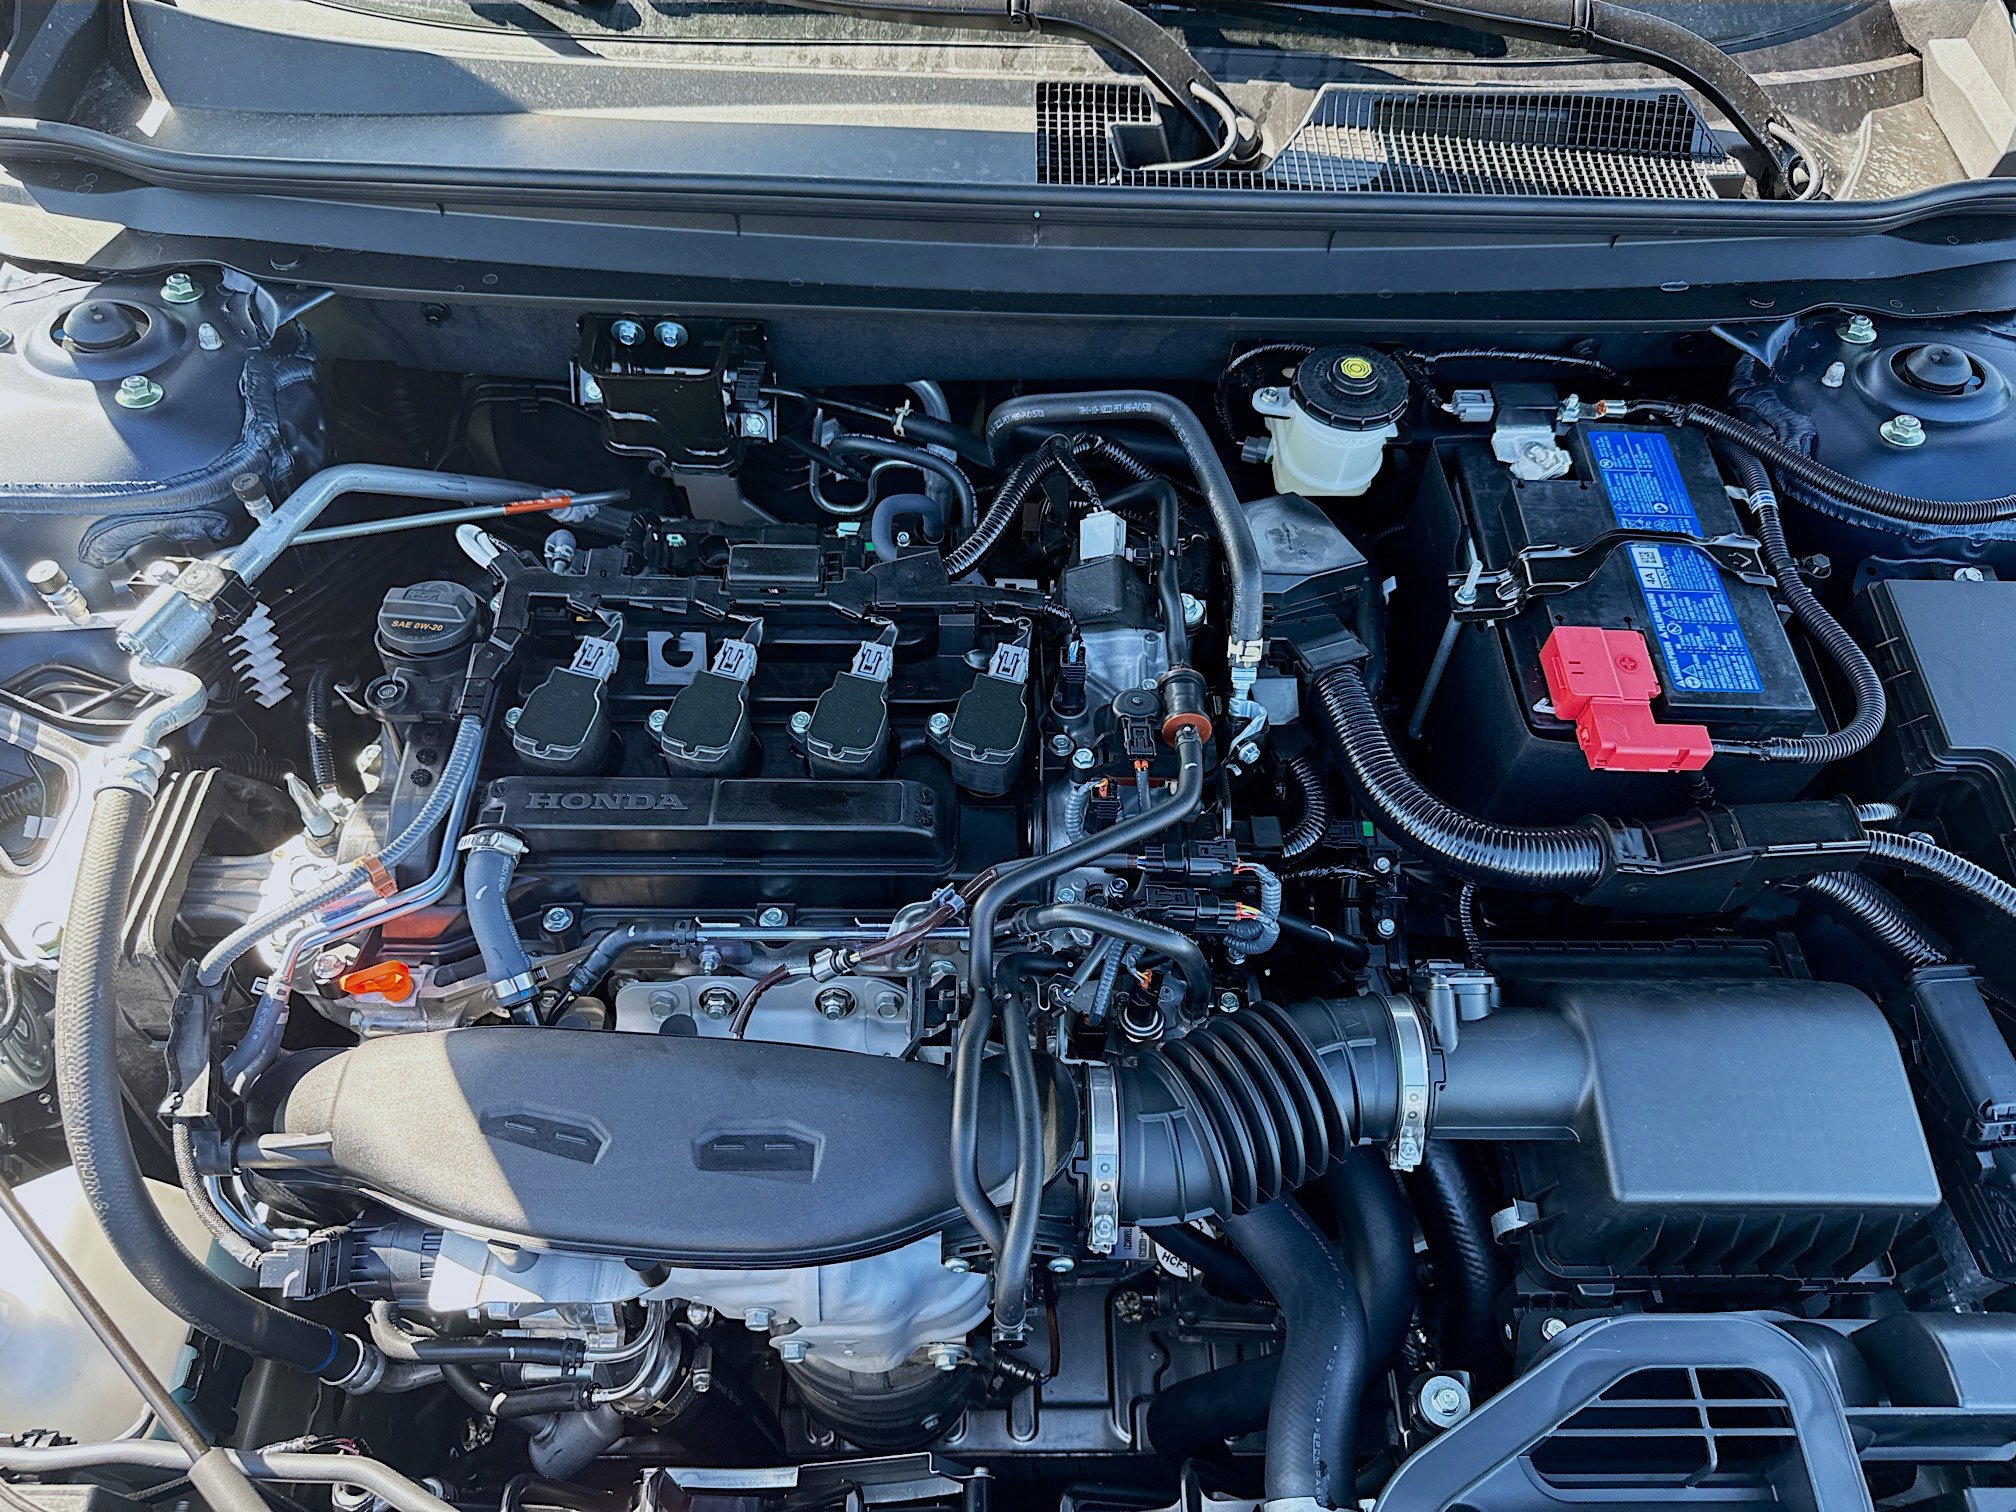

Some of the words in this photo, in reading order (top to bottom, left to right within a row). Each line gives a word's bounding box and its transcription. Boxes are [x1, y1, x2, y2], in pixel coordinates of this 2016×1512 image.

[391, 620, 413, 629] SAE
[413, 622, 444, 631] 0W-20
[525, 791, 688, 811] HONDA
[68, 1123, 103, 1194] NICHIRIN
[1161, 1251, 1190, 1273] HCF-
